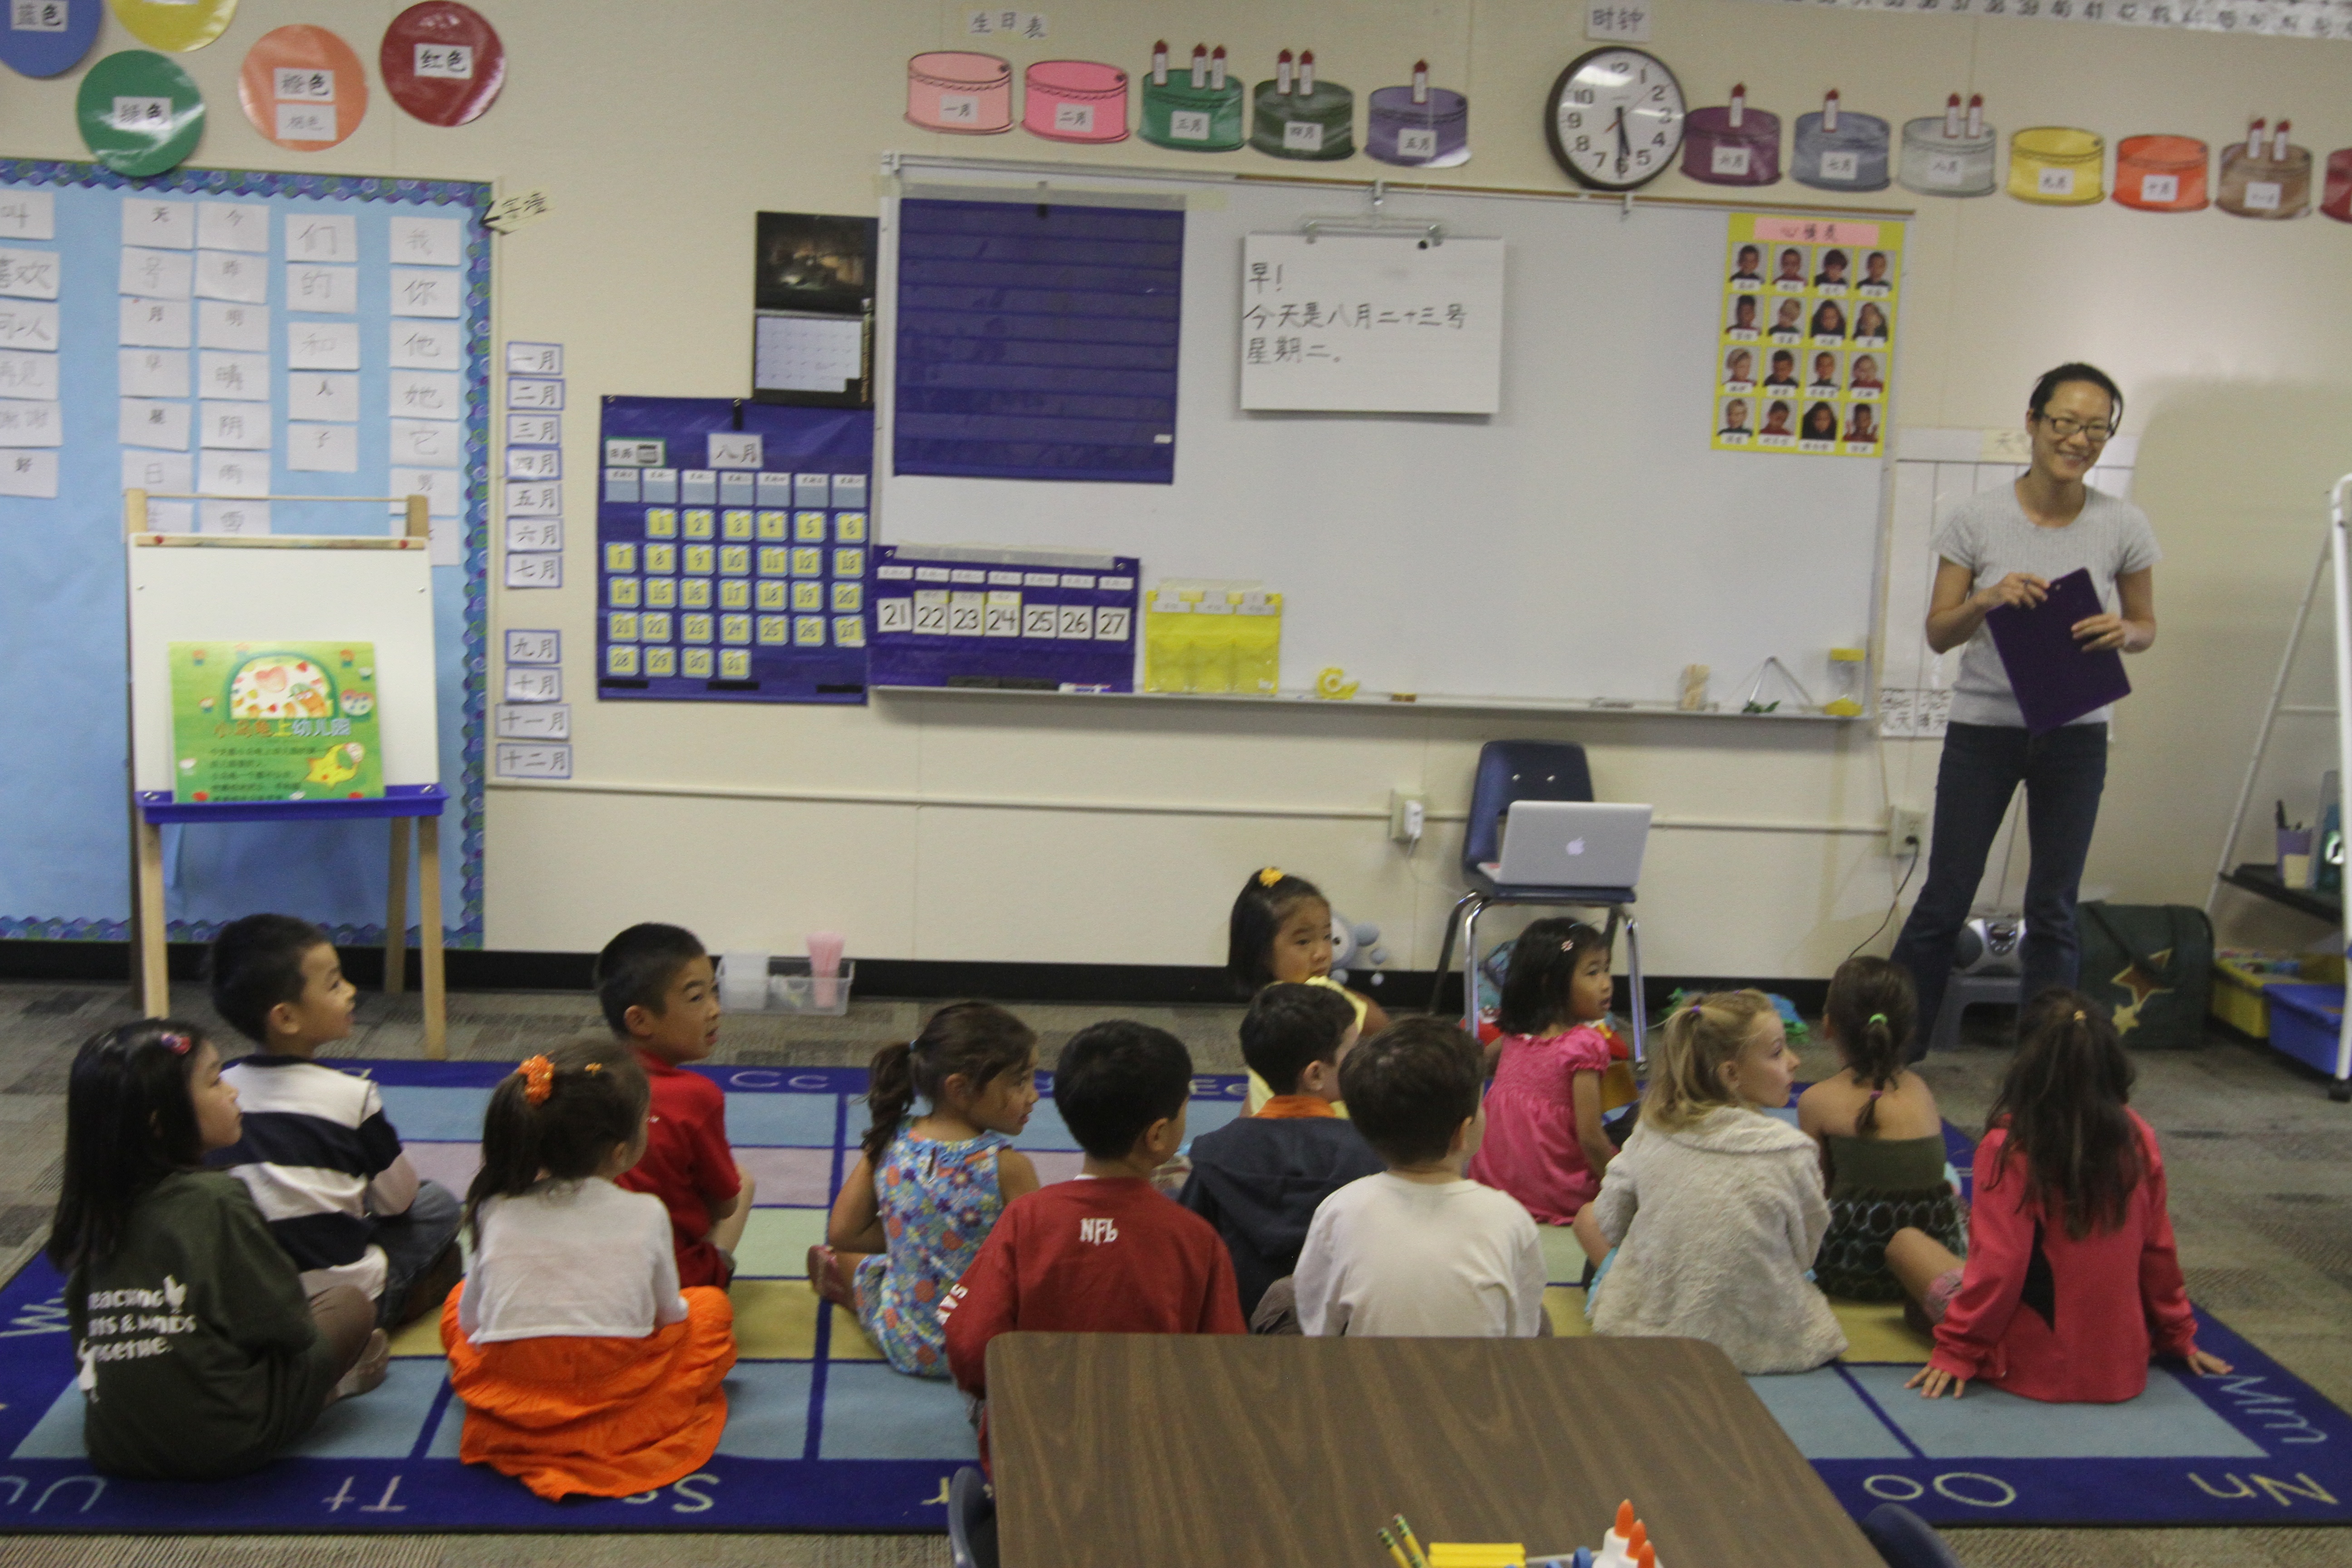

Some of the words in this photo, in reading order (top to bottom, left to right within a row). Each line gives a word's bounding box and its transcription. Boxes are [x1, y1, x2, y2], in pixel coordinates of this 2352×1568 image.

[970, 11, 1046, 39] 生日表
[420, 49, 467, 74] 红色
[1639, 68, 1647, 83] 1
[1573, 89, 1595, 105] 10
[1651, 84, 1666, 102] 2
[1567, 112, 1582, 129] 9
[1575, 136, 1591, 152] 8
[1651, 132, 1666, 148] 4
[1592, 152, 1607, 168] 7
[1637, 149, 1652, 166] 5
[403, 279, 438, 306] 你
[513, 350, 554, 371] 一月
[514, 385, 555, 406] 二月
[513, 421, 554, 441] 三月
[714, 443, 757, 463] 八月
[514, 488, 554, 509] 五月
[515, 524, 556, 545] 六月
[514, 559, 554, 580] 七月
[883, 603, 906, 626] 21
[917, 606, 945, 628] 22
[953, 608, 978, 630] 23
[988, 610, 1015, 631] 24
[1027, 610, 1054, 632] 25
[1063, 612, 1088, 633] 26
[1099, 613, 1126, 634] 27
[513, 637, 553, 658] 九月
[513, 674, 554, 696] 十月
[502, 710, 564, 731] 十一月
[503, 750, 565, 771] 十二月
